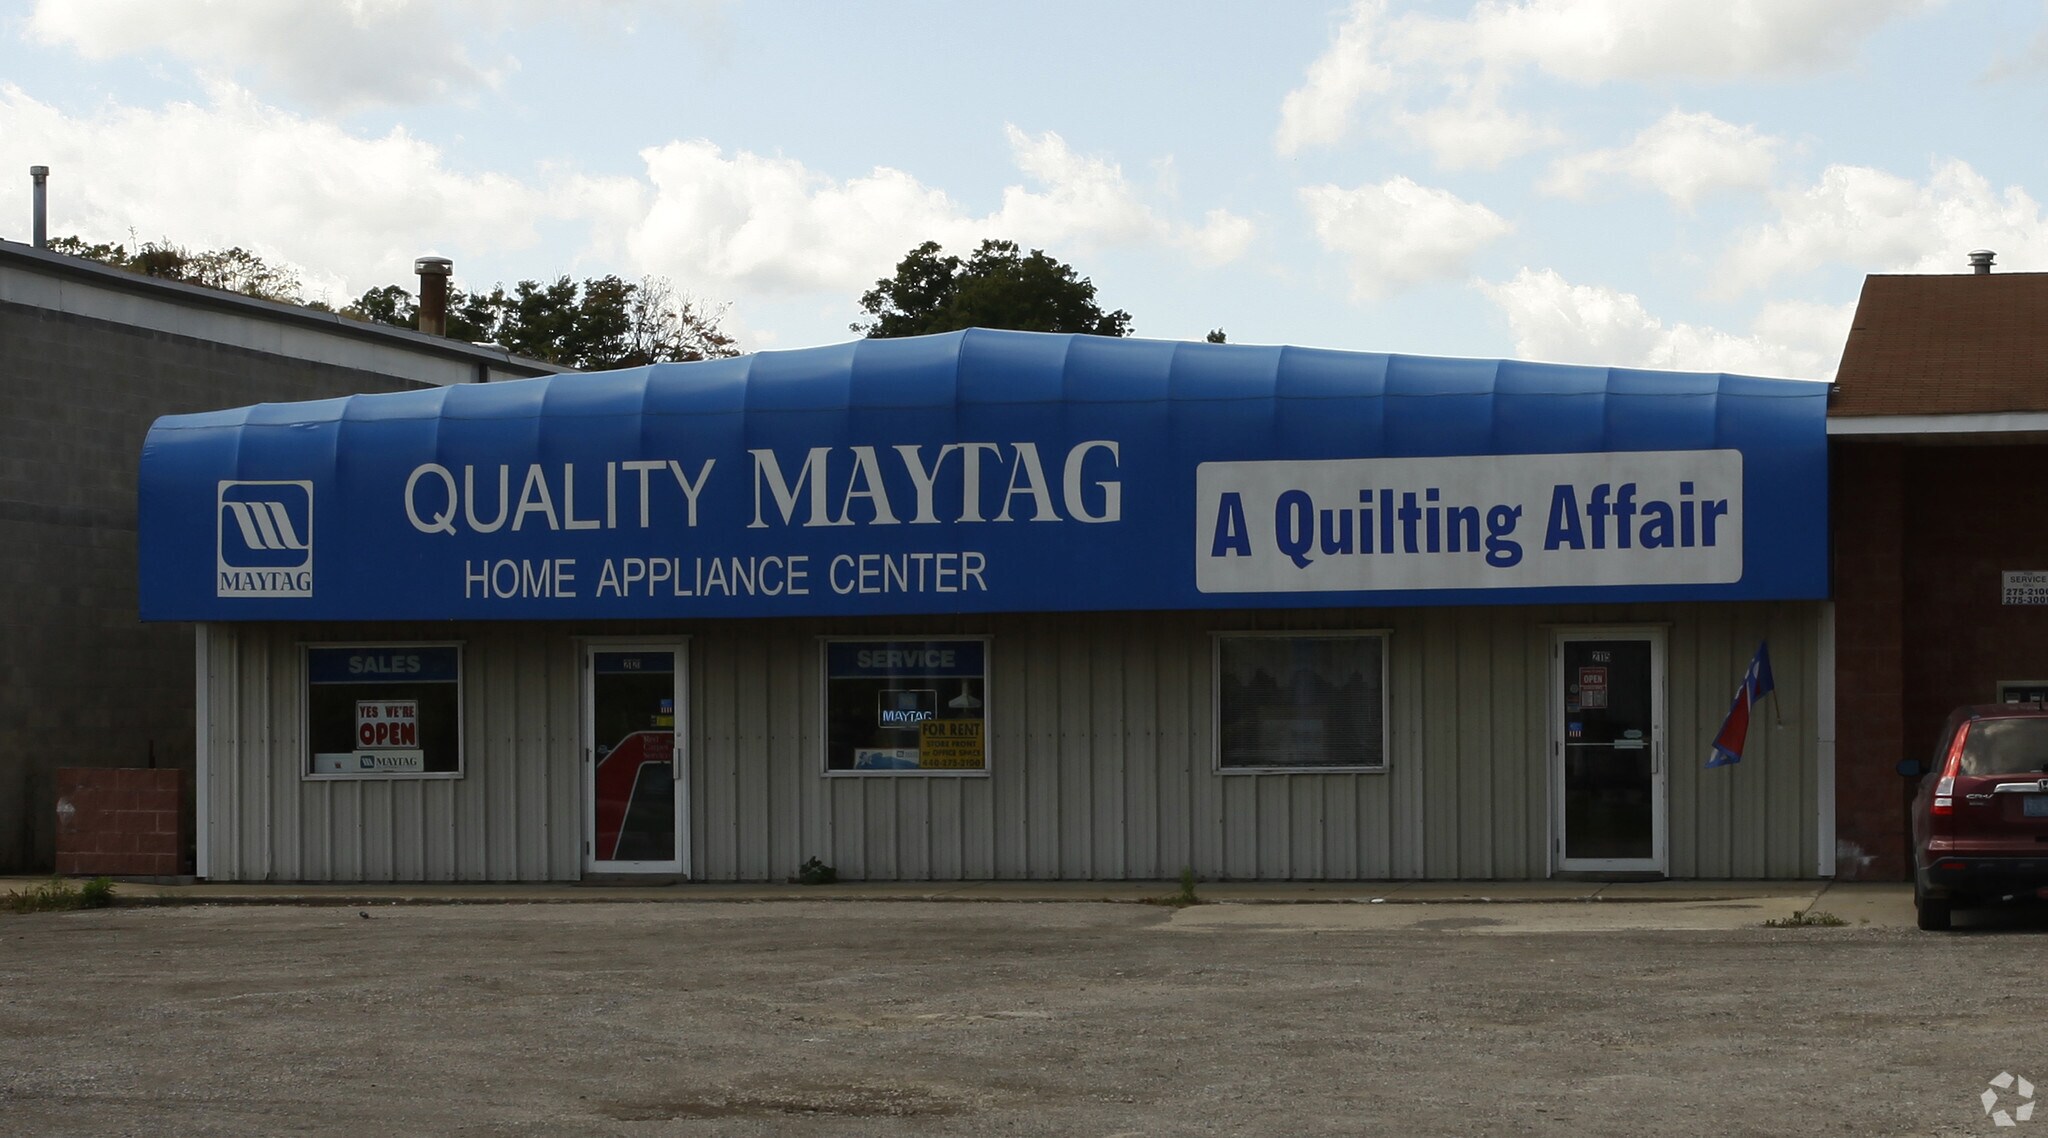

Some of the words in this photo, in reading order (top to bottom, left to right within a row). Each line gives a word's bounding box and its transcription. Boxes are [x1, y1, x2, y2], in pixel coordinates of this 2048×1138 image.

[404, 458, 716, 536] QUALITY
[747, 440, 1122, 529] MAYTAG
[1211, 492, 1252, 557] A
[1275, 487, 1523, 569] Quilting
[1543, 481, 1728, 550] Affair
[220, 571, 312, 592] MAYTAG
[465, 559, 577, 599] HOME
[595, 554, 810, 599] APPLIANCE
[829, 551, 988, 595] CENTER
[2010, 575, 2046, 583] SERVICE
[349, 656, 421, 673] SALES
[857, 650, 956, 668] SERVICE
[1583, 674, 1603, 684] OPEN
[359, 706, 379, 718] YES
[385, 706, 415, 718] WE'RE
[882, 710, 932, 722] MAYTAG
[359, 722, 416, 746] OPEN
[922, 723, 945, 736] FOR
[950, 723, 980, 736] RENT
[376, 757, 416, 766] MAYTAG
